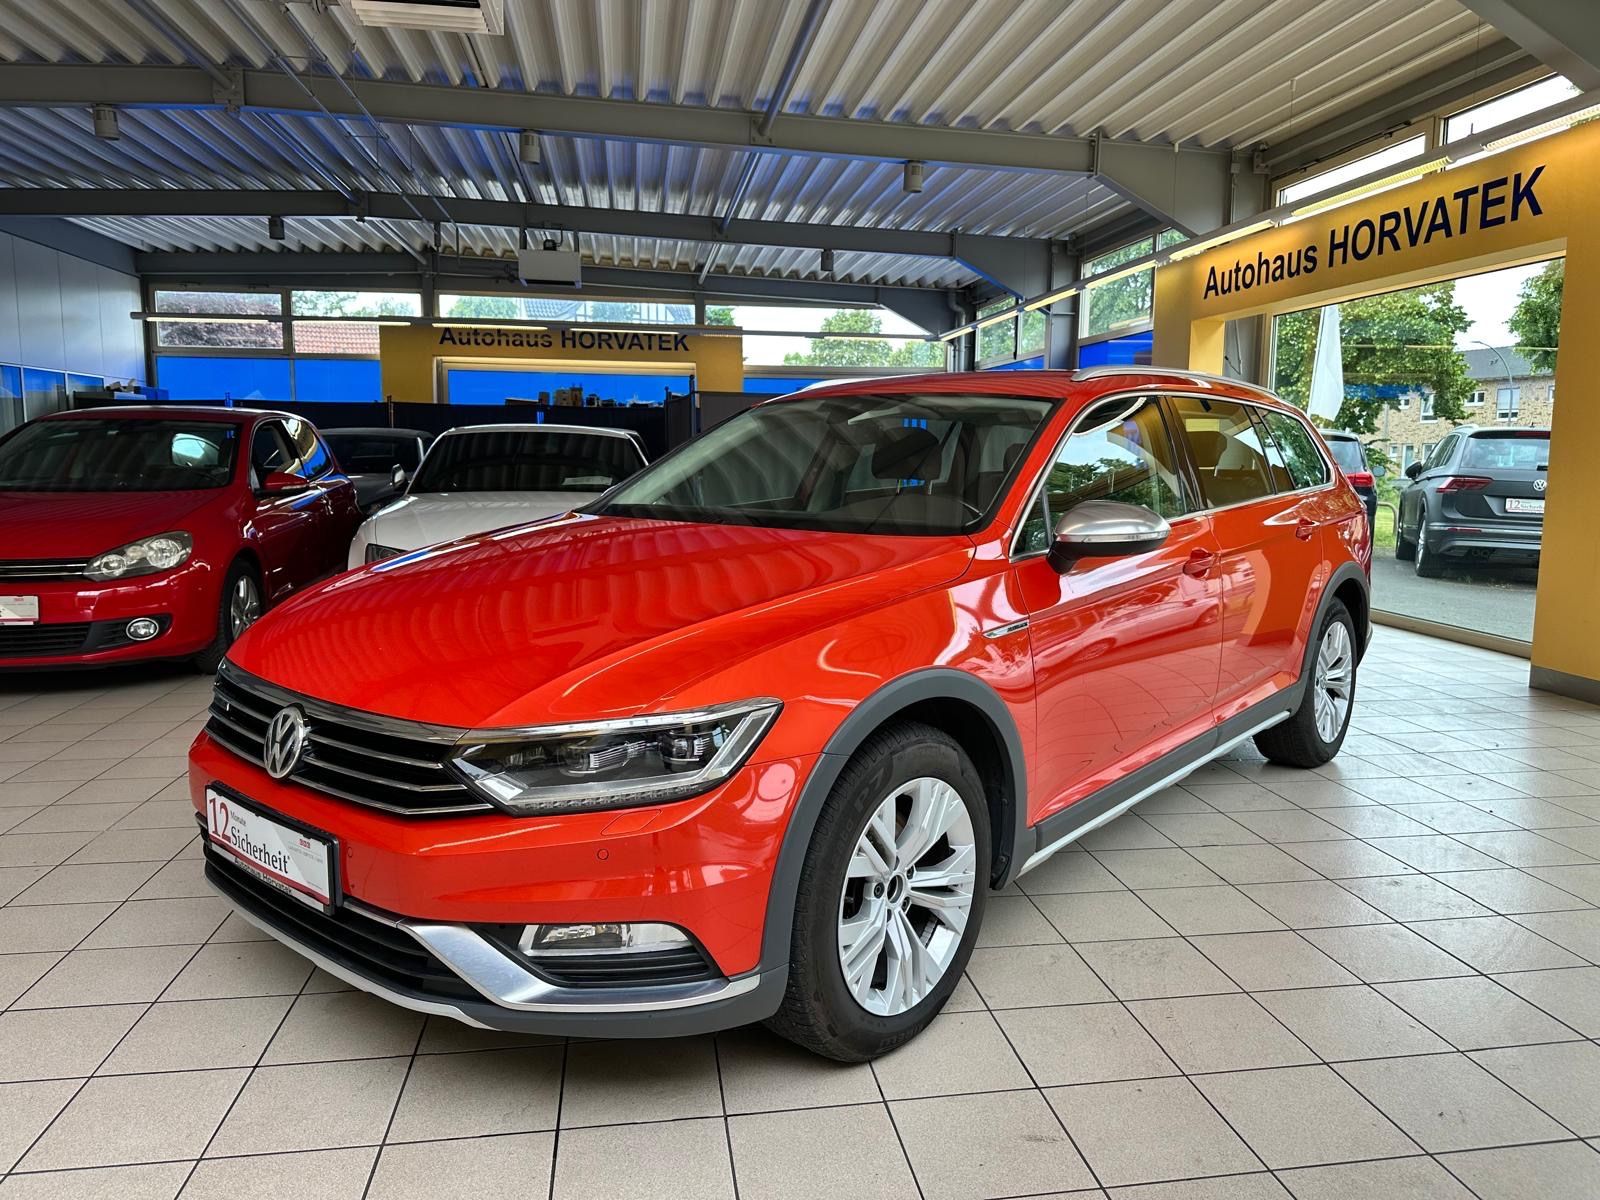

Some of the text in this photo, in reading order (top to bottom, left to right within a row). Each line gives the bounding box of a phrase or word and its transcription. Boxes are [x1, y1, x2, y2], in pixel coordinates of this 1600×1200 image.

[1204, 165, 1546, 299] Autohaus HORVATEK
[438, 327, 690, 351] Autohaus HORVATEK
[209, 797, 231, 844] 12
